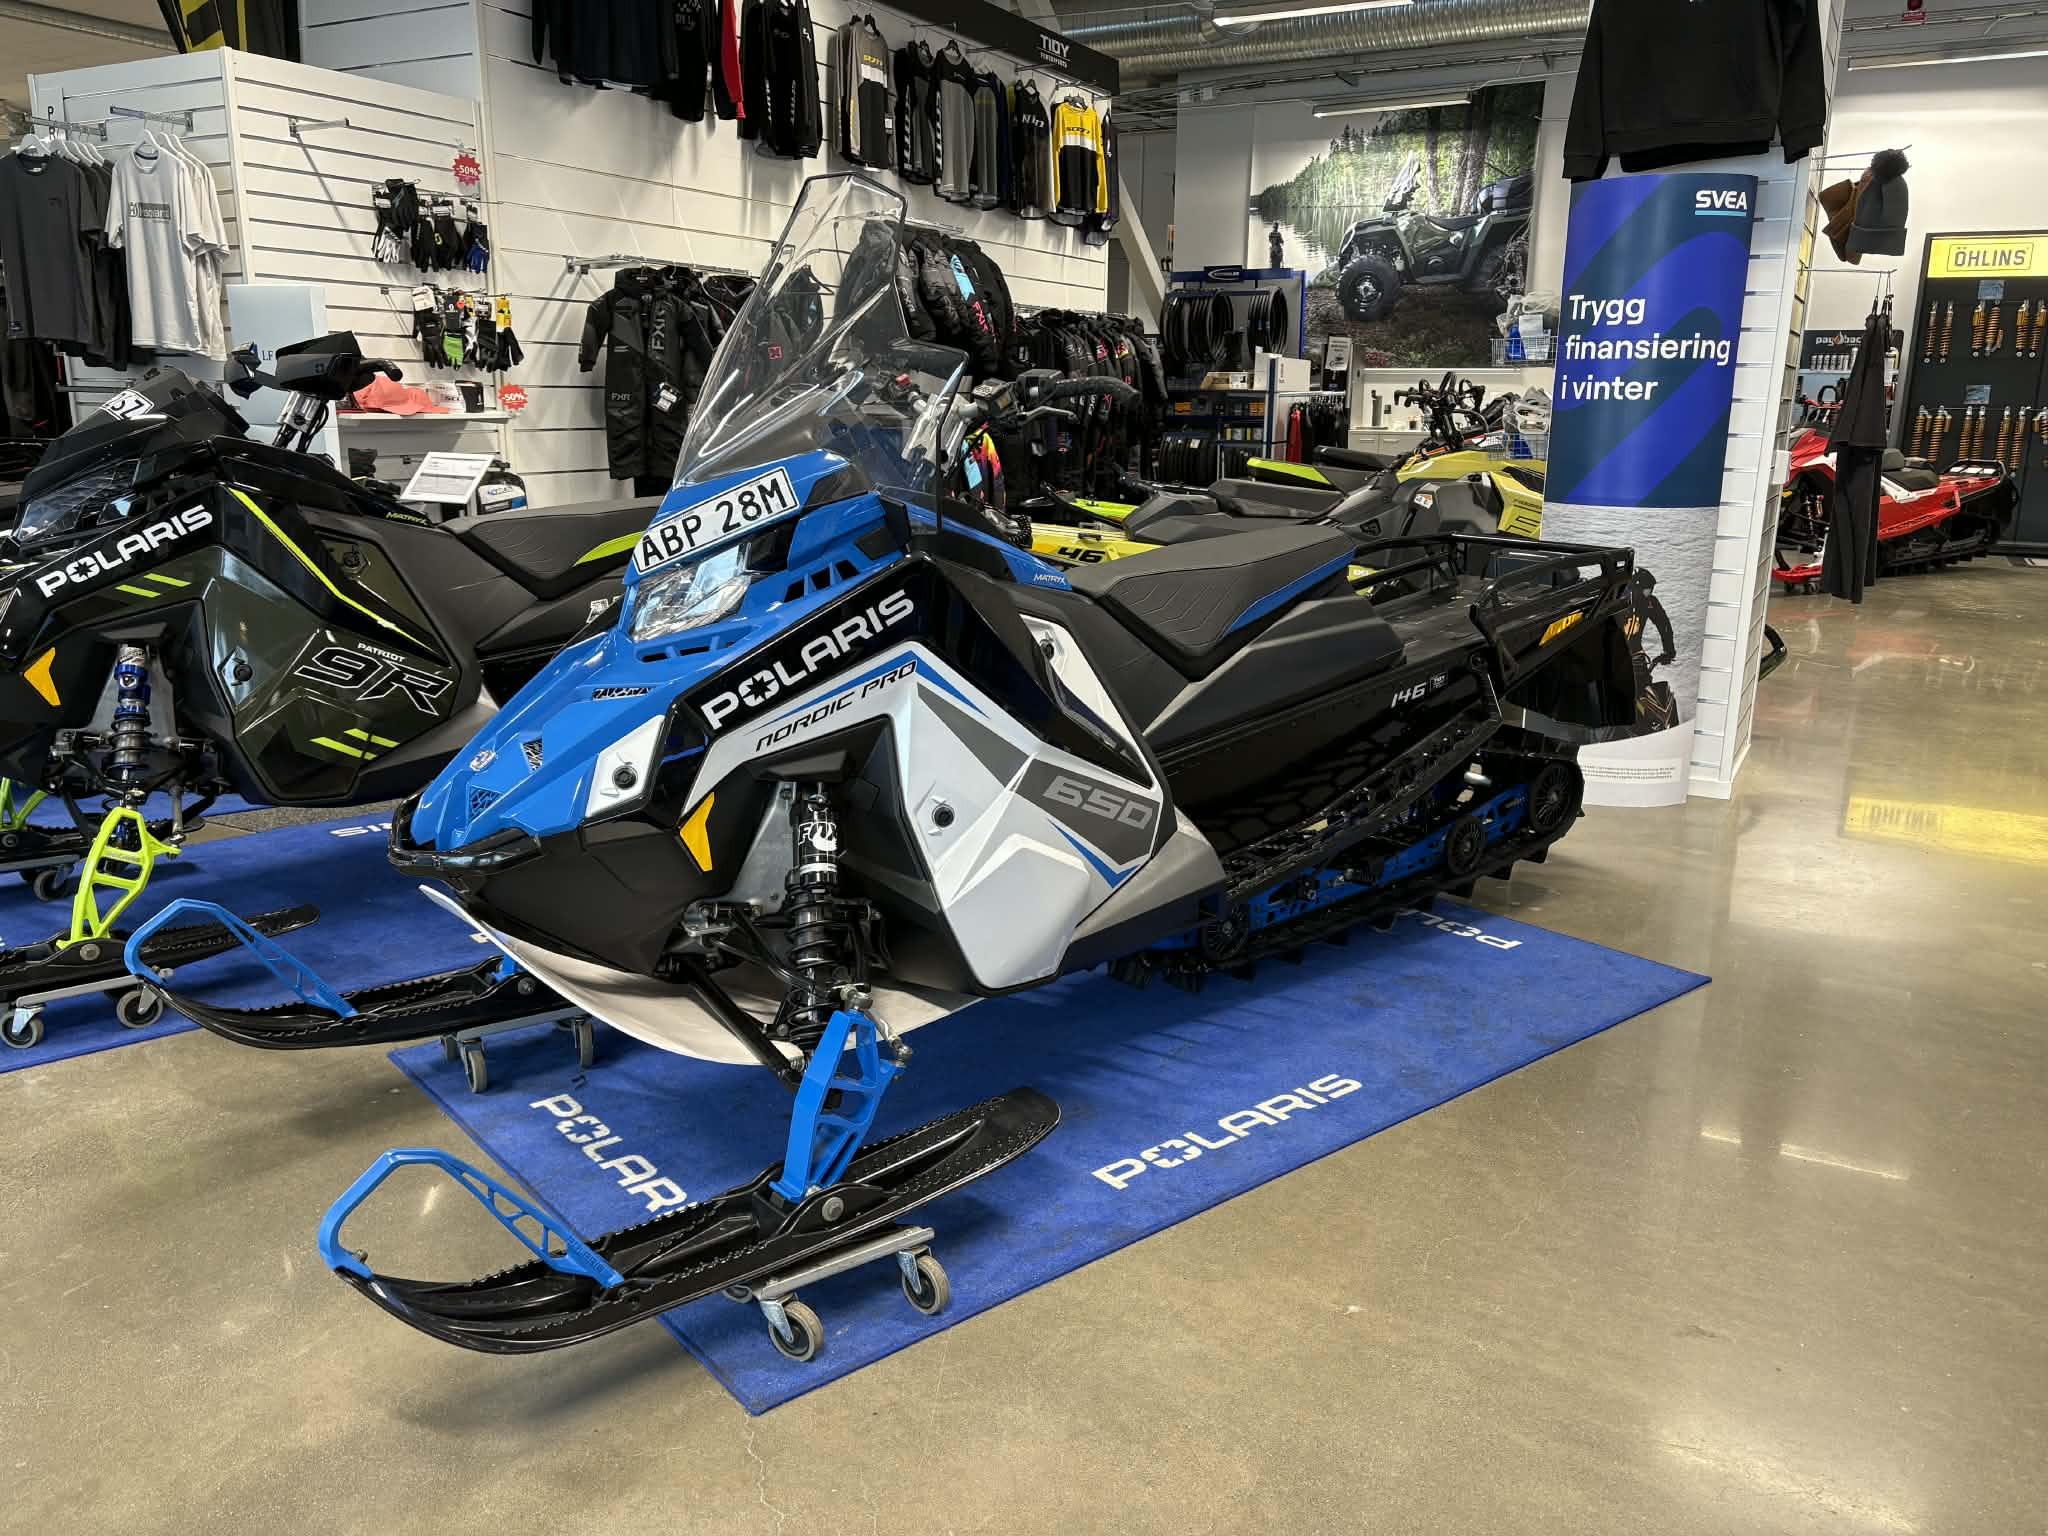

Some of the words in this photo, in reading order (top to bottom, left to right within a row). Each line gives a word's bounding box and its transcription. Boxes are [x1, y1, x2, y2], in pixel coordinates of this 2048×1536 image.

[1040, 33, 1070, 58] TIDY
[1695, 190, 1748, 210] SVEA
[1954, 246, 2027, 267] ÖHLINS
[1568, 294, 1646, 326] Trygg
[1565, 332, 1731, 366] finansiering
[1561, 374, 1568, 400] i
[1572, 374, 1658, 401] vinter
[641, 513, 702, 569] ABP
[714, 477, 788, 536] 28M
[35, 503, 214, 599] POLARIS
[1057, 546, 1106, 563] 46
[357, 642, 406, 663] PATRIOT
[700, 589, 915, 731] POLARIS
[293, 646, 454, 717] 9R
[1390, 681, 1427, 709] 146
[755, 690, 856, 752] NORDIC
[861, 659, 918, 699] PRO
[1042, 774, 1154, 831] 650
[1090, 1073, 1364, 1191] POLARIS
[529, 1093, 697, 1222] POLAR
